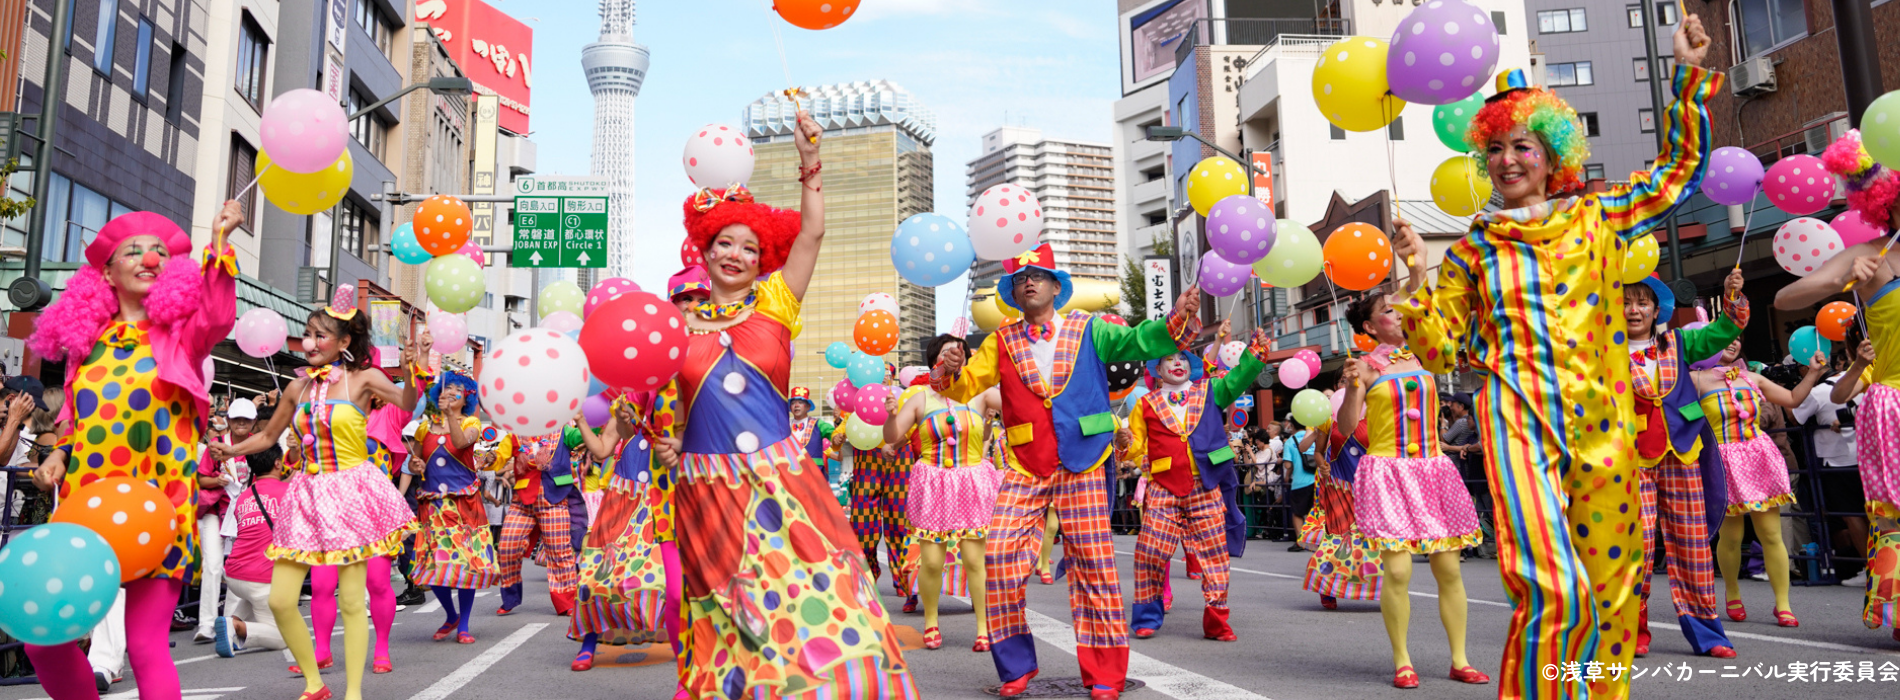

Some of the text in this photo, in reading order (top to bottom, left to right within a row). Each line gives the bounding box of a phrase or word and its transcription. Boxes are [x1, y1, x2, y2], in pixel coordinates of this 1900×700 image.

[522, 180, 529, 190] 6
[537, 181, 567, 191] 首都高
[520, 200, 555, 211] 向島入口
[567, 200, 603, 211] 駒形入口
[521, 216, 534, 225] E6
[567, 217, 577, 226] C1
[518, 228, 555, 240] 常磐道
[564, 229, 604, 240] 都心環状
[514, 241, 558, 250] JOBAN EXP
[565, 241, 602, 249] Circle 1
[241, 515, 267, 527] STAFF
